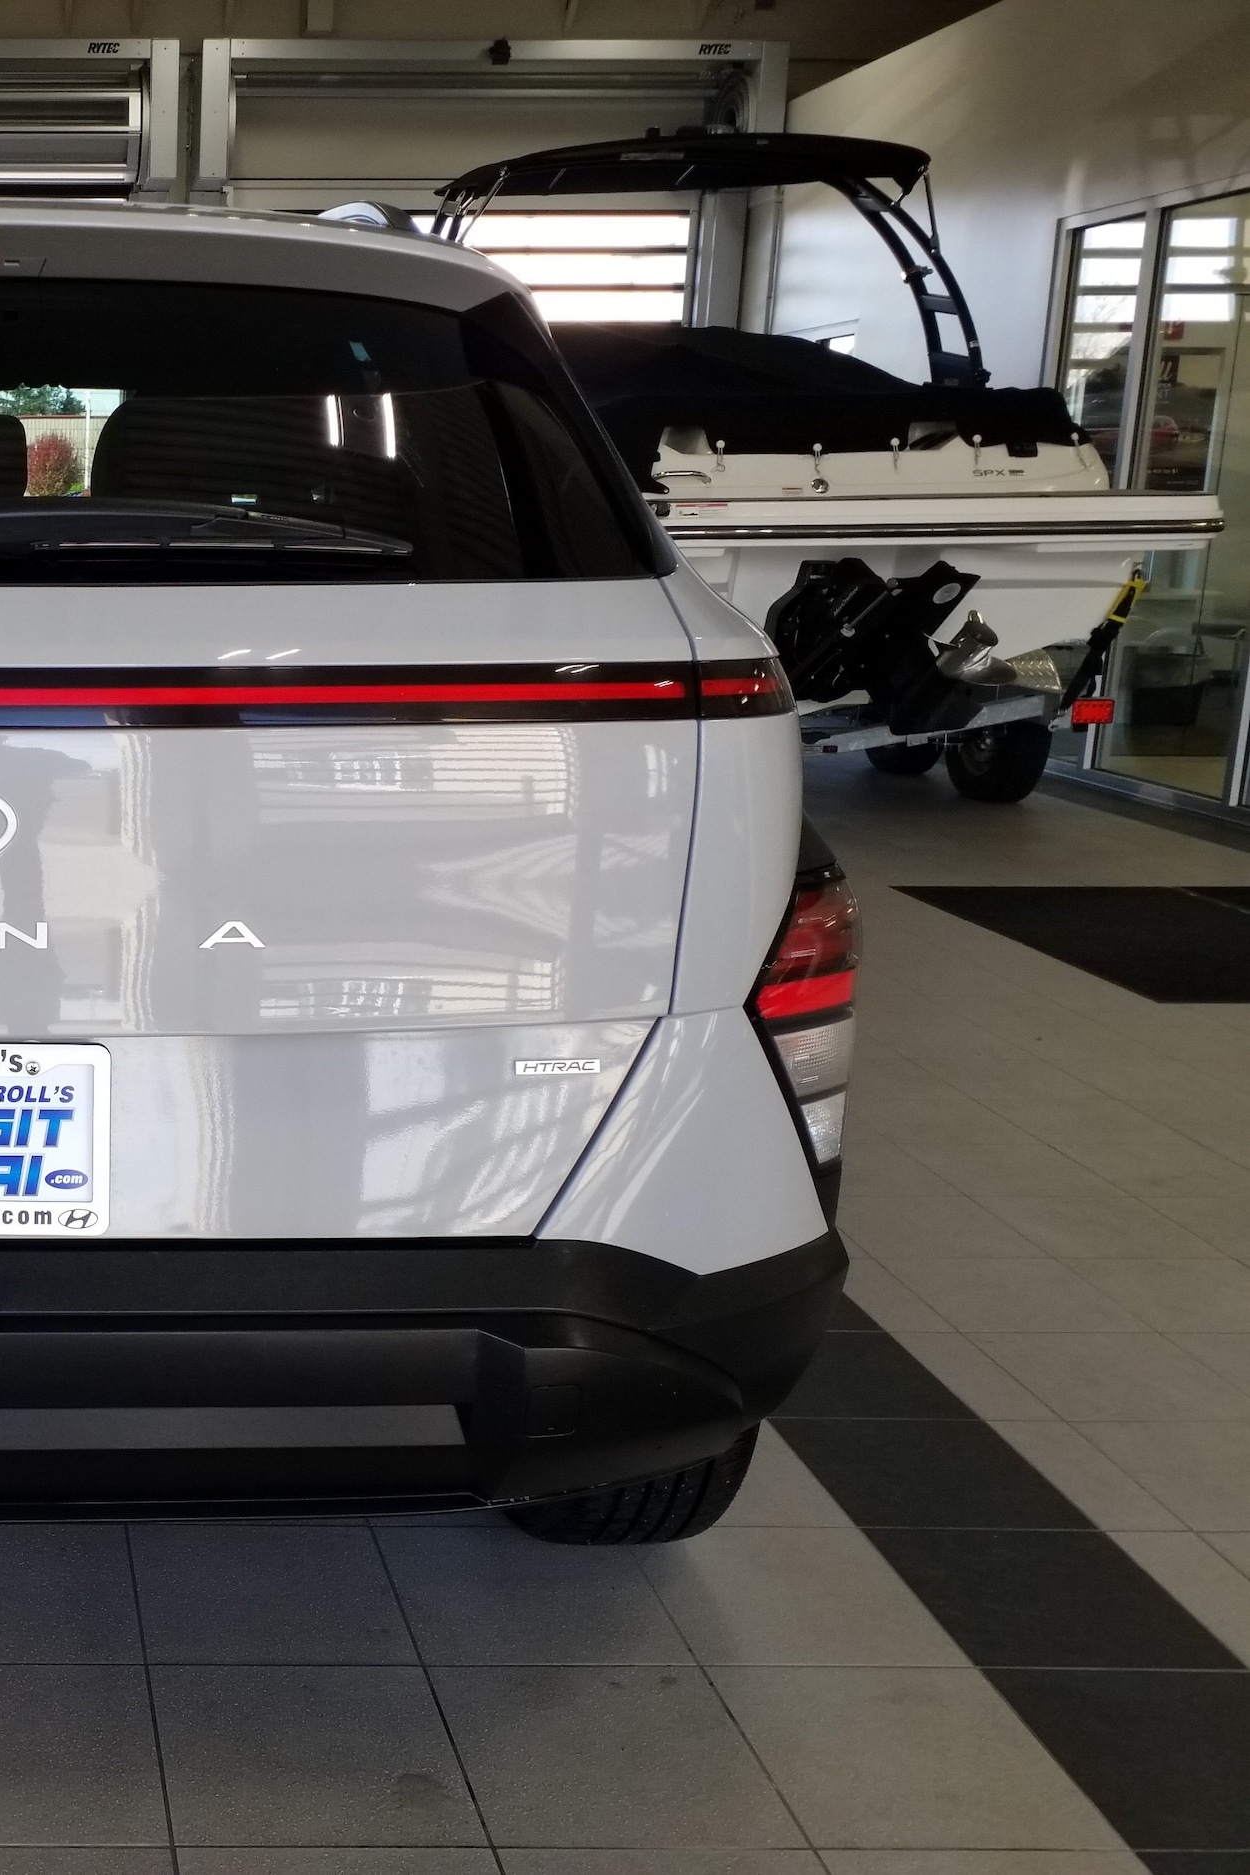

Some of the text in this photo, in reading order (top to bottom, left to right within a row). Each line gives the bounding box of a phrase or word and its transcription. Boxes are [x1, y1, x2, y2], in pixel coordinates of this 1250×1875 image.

[87, 42, 120, 54] RYTEC
[698, 43, 732, 55] RYTEC
[972, 469, 1005, 477] SPX
[523, 1061, 595, 1072] HTRAC
